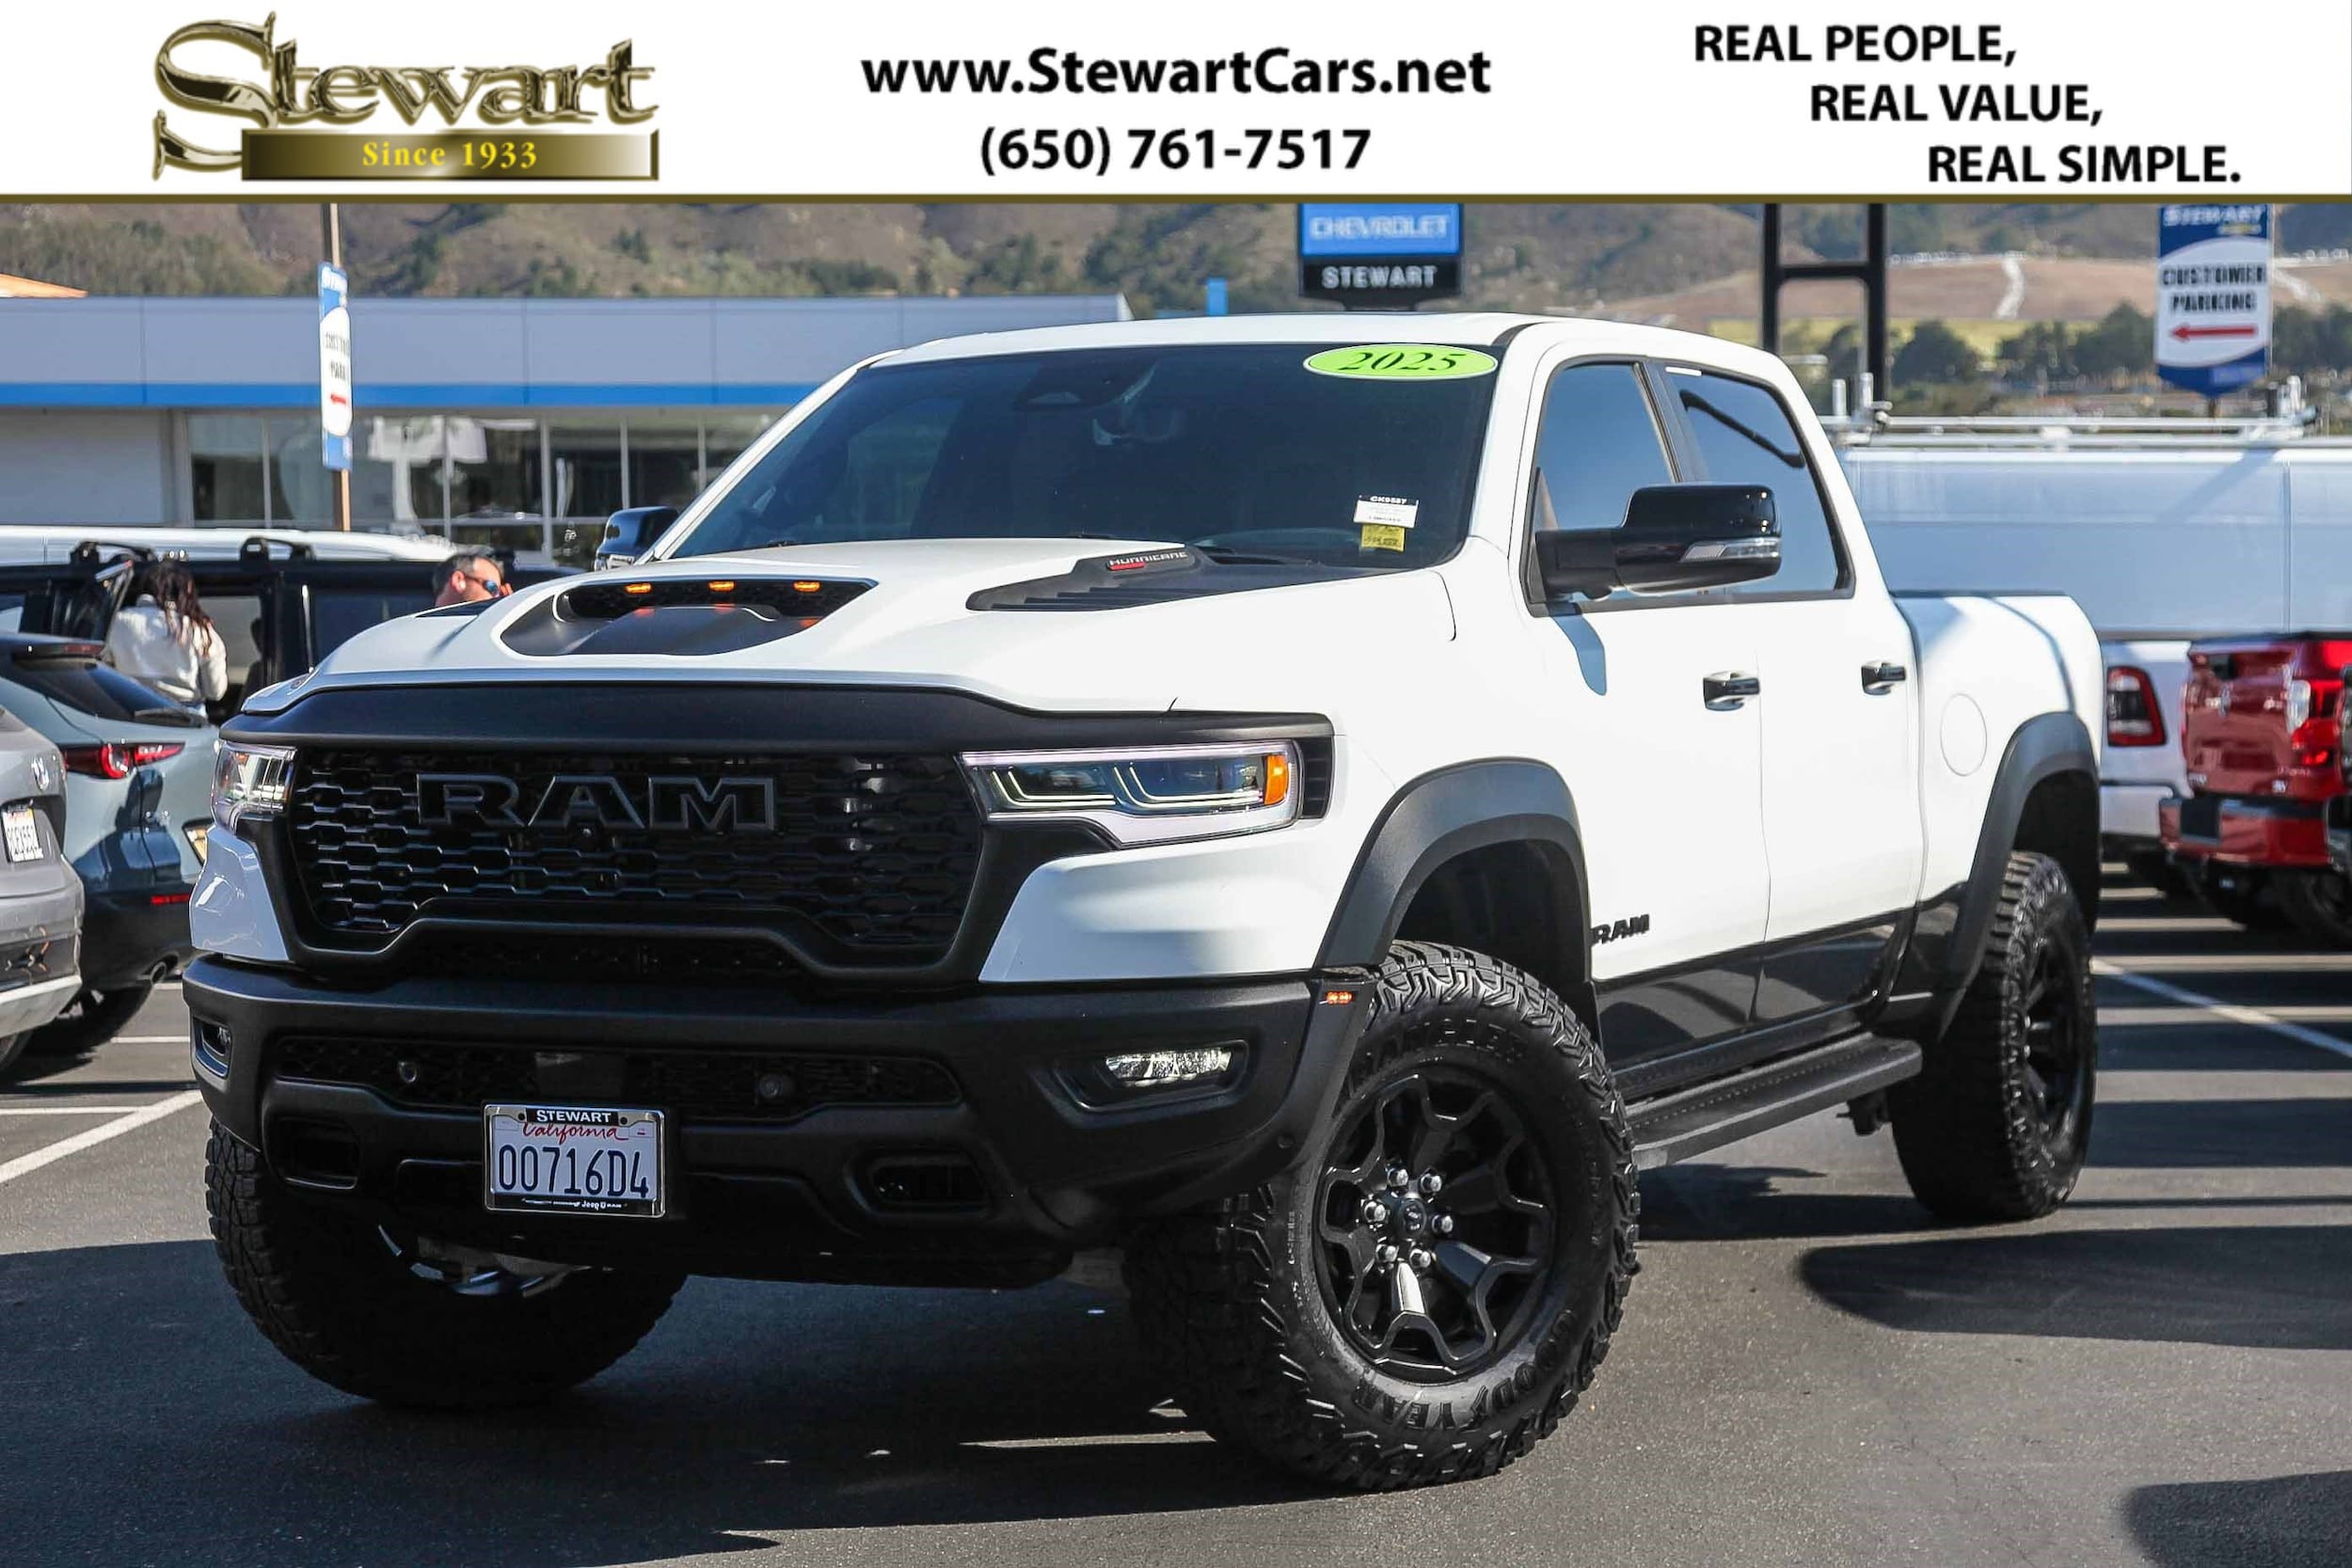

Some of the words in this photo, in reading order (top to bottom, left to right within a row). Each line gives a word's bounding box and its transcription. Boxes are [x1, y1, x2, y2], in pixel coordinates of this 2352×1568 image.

[1311, 214, 1449, 239] CHEVROLET
[1321, 264, 1438, 289] STEWART
[1337, 351, 1467, 372] 2025
[1108, 551, 1188, 566] HURRICANE
[417, 773, 775, 830] RAM
[1591, 913, 1649, 945] RAM
[536, 1109, 612, 1123] STEWART
[522, 1121, 629, 1146] California
[499, 1144, 649, 1198] 00716D4
[1352, 1307, 1578, 1432] GOODYEAR
